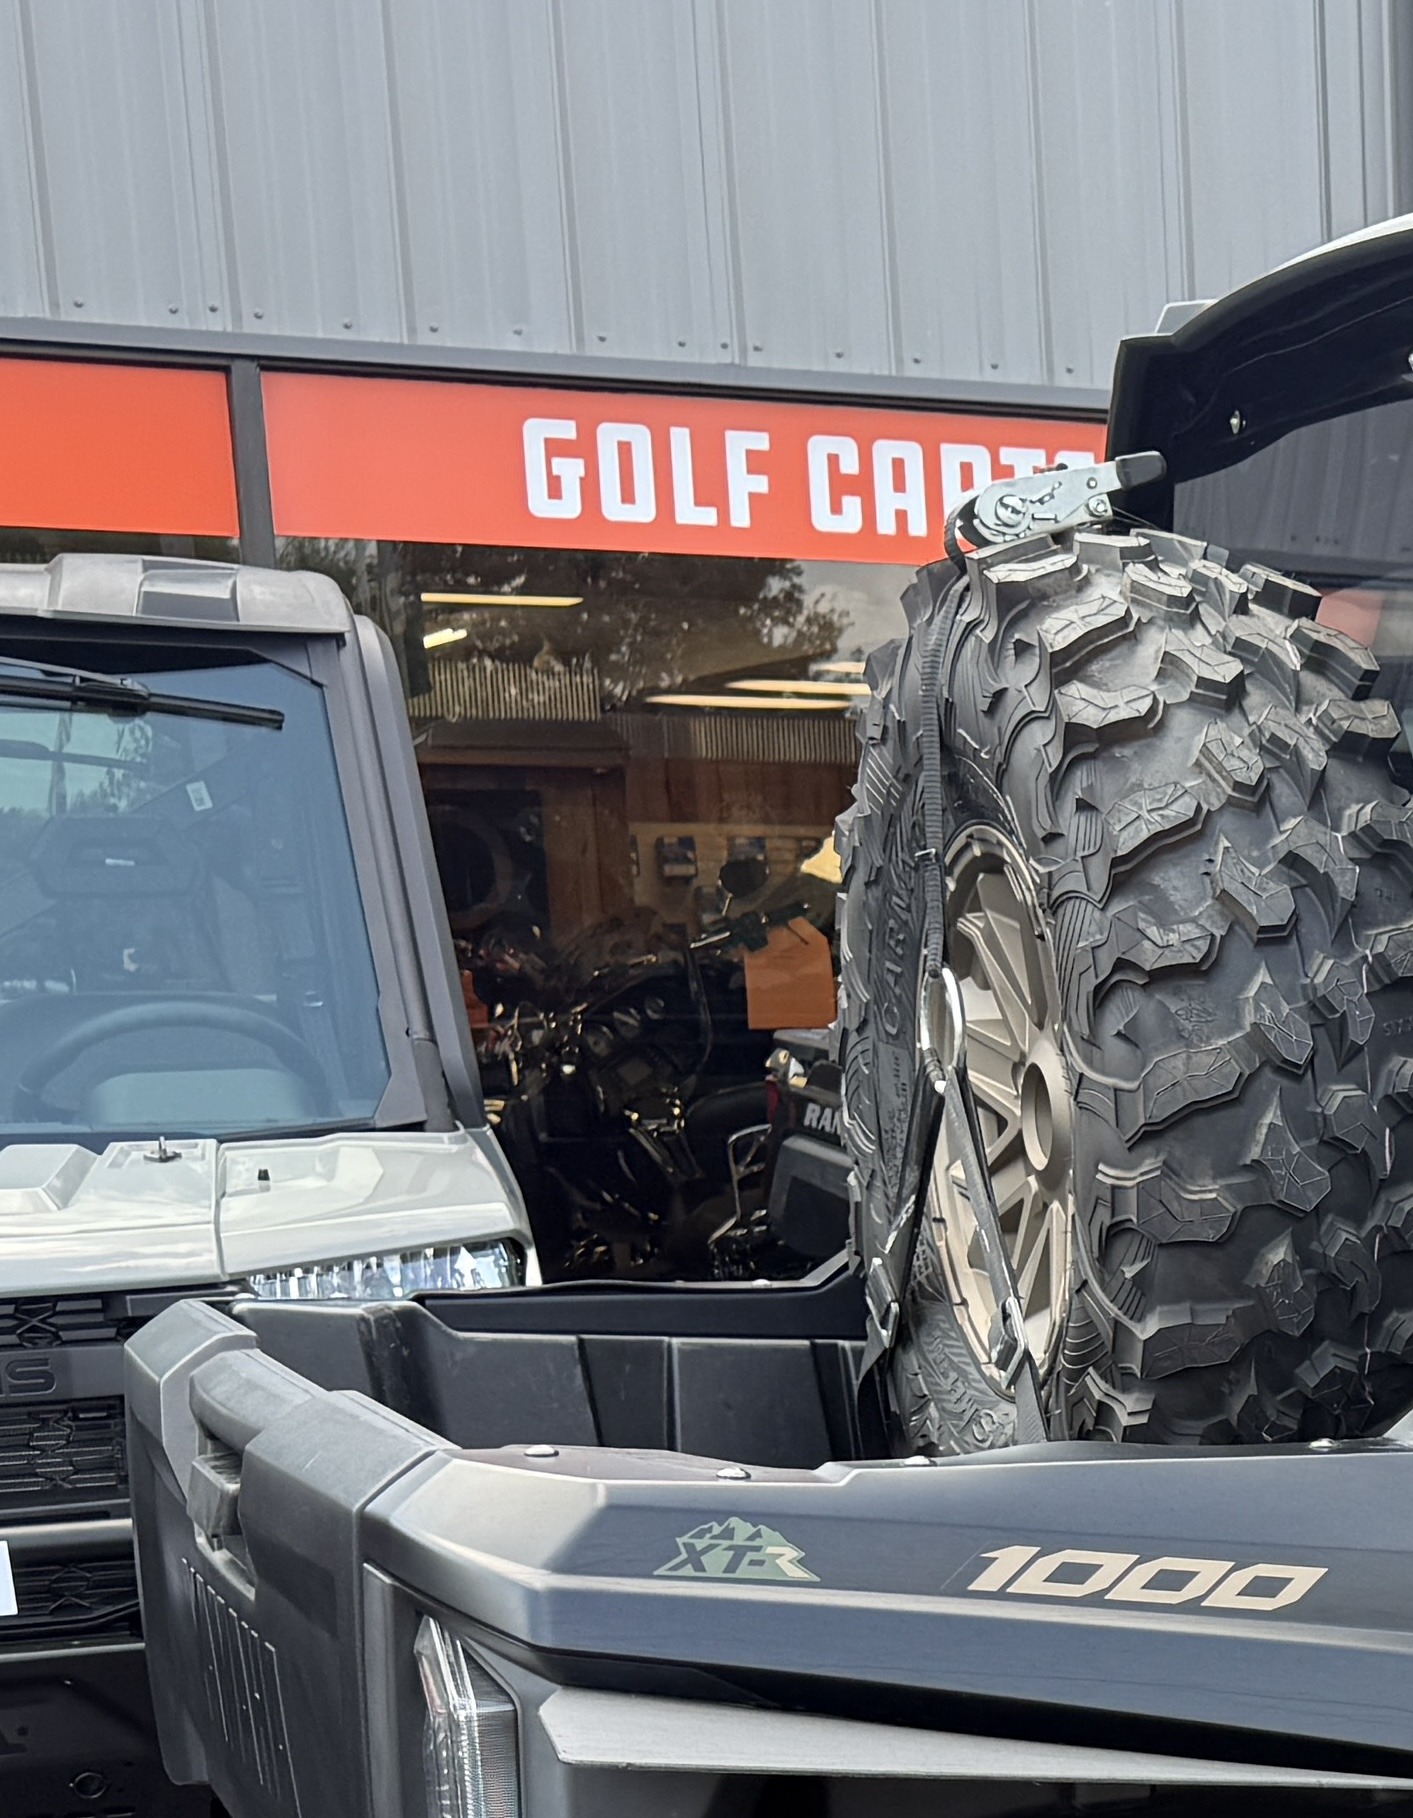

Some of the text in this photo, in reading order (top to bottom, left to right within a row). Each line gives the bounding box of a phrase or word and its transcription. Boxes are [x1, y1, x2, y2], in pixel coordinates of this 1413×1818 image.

[522, 417, 1097, 537] GOLF CAR
[665, 1541, 810, 1579] XT-R
[967, 1545, 1328, 1611] 1000
